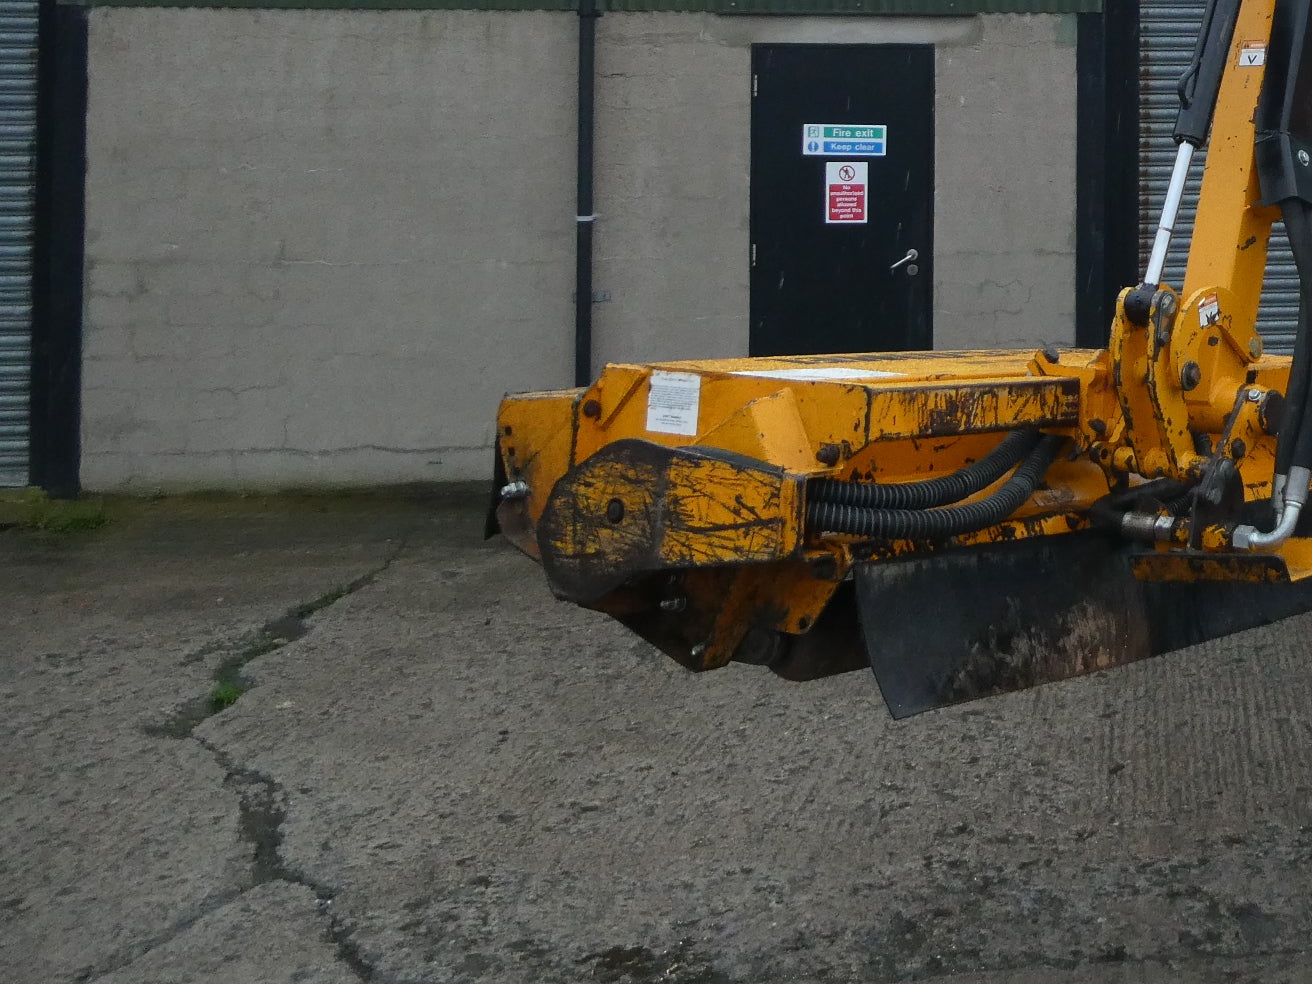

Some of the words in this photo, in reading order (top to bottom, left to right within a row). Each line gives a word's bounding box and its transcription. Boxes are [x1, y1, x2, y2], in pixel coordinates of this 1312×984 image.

[832, 127, 852, 137] Fire
[855, 128, 874, 138] exit
[830, 142, 852, 152] Keep
[854, 142, 875, 151] clear
